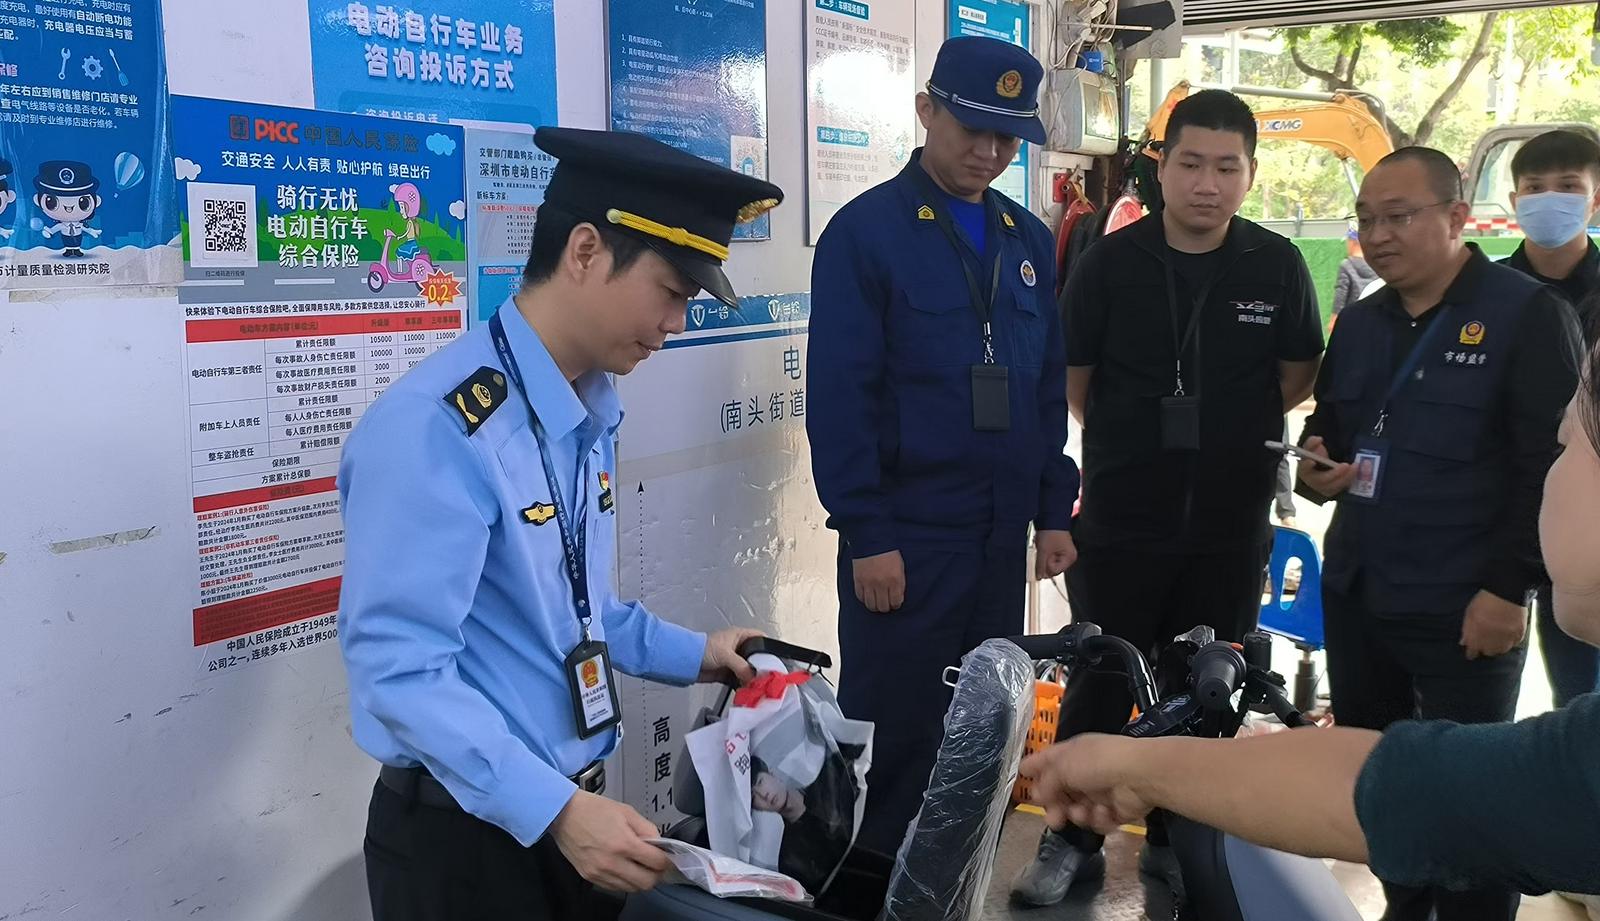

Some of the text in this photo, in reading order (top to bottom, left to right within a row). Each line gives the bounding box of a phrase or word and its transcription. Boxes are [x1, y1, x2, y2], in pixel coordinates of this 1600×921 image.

[348, 1, 524, 55] 电动自行车业务
[364, 42, 515, 91] 咨询投诉方式
[0, 112, 118, 129] 请及时到专业维修店进行维修。
[254, 119, 299, 144] PICC
[221, 150, 431, 180] 交通安全 人人有责 贴心护航 绿色出行
[277, 184, 359, 212] 骑行无忧
[267, 215, 369, 241] 电动自行车
[278, 243, 360, 269] 综合保险
[428, 284, 449, 302] 0.2
[295, 338, 336, 348] 累计责任限额
[370, 335, 392, 343] 105000
[404, 333, 425, 341] 110000
[436, 332, 456, 340] 110000
[275, 351, 356, 364] 每次事故人身伤亡责任限额
[370, 349, 393, 357] 100000
[404, 347, 425, 355] 100000
[374, 363, 390, 371] 3000
[783, 345, 802, 380] 电
[191, 364, 263, 378] 电动自行车第三者责任
[275, 365, 357, 379] 每次事故医疗费用责任限额
[276, 379, 357, 393] 每次事故财产损失责任限额
[375, 376, 391, 384] 2000
[298, 395, 339, 406] 累计责任限额
[285, 407, 352, 423] 每人人身伤亡责任限额
[720, 388, 805, 433] (南头街道
[199, 417, 261, 432] 附加车上人员责任
[285, 421, 353, 437] 每人医疗费用责任限额
[300, 436, 341, 449] 累计赔偿限额
[208, 448, 255, 462] 整车盗抢责任
[271, 456, 301, 468] 保险期限
[261, 469, 312, 485] 方案累计总保额
[226, 615, 337, 652] 中国人民保险成立于1949年
